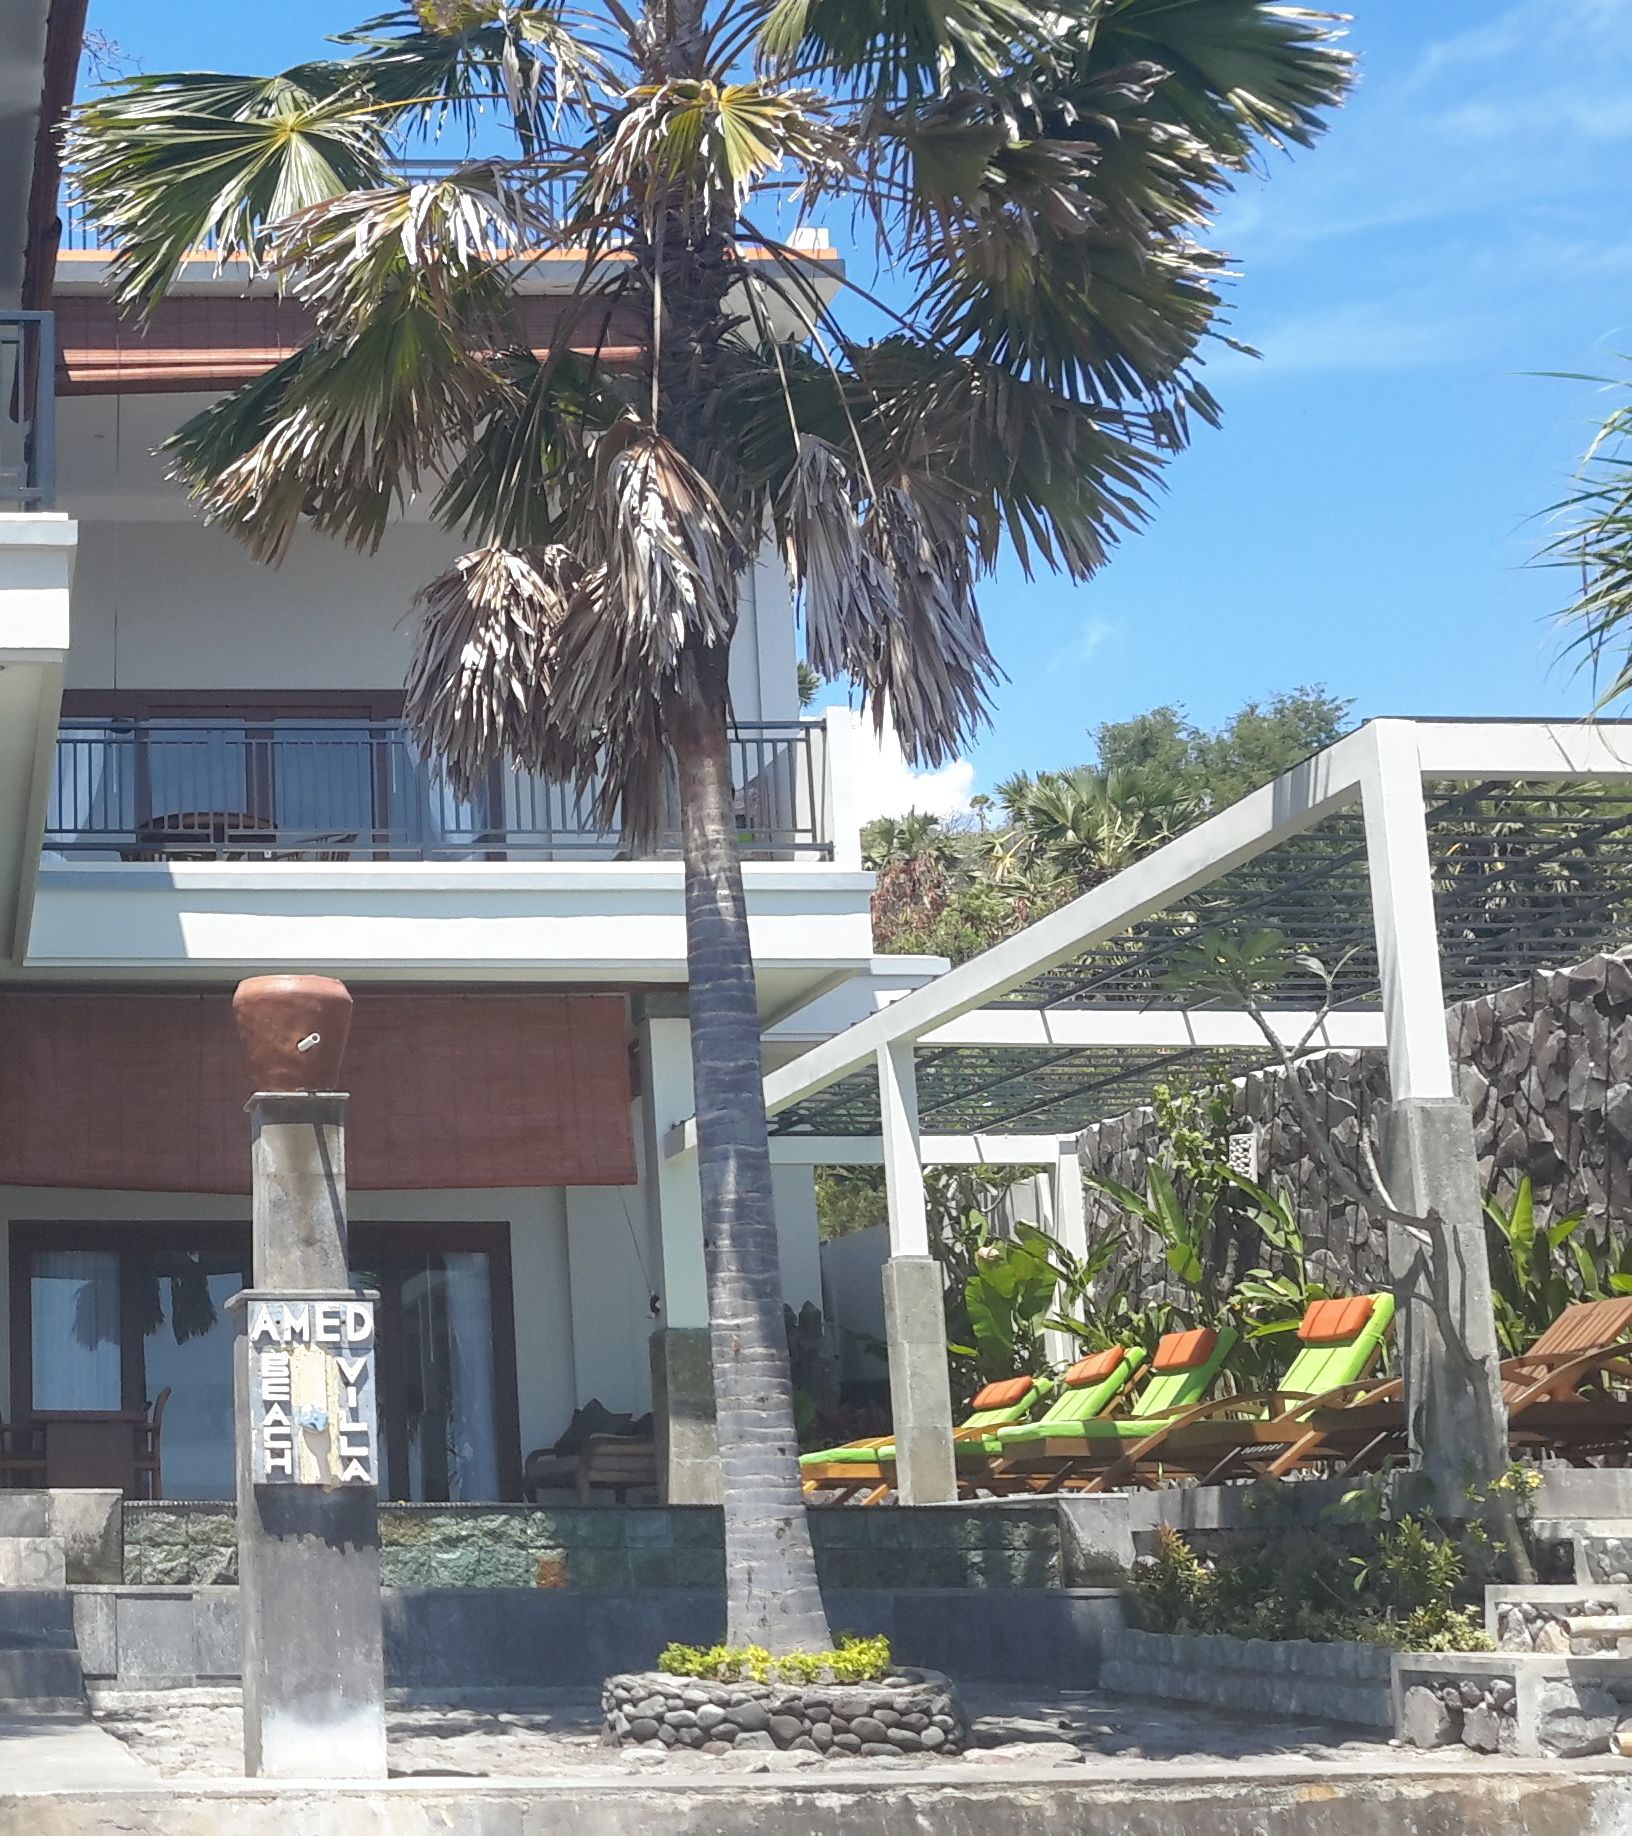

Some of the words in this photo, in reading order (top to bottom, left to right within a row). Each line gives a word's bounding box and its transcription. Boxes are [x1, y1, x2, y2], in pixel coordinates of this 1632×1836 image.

[254, 1305, 372, 1342] AMED
[262, 1352, 291, 1475] BEACH
[338, 1358, 371, 1481] VILLA
